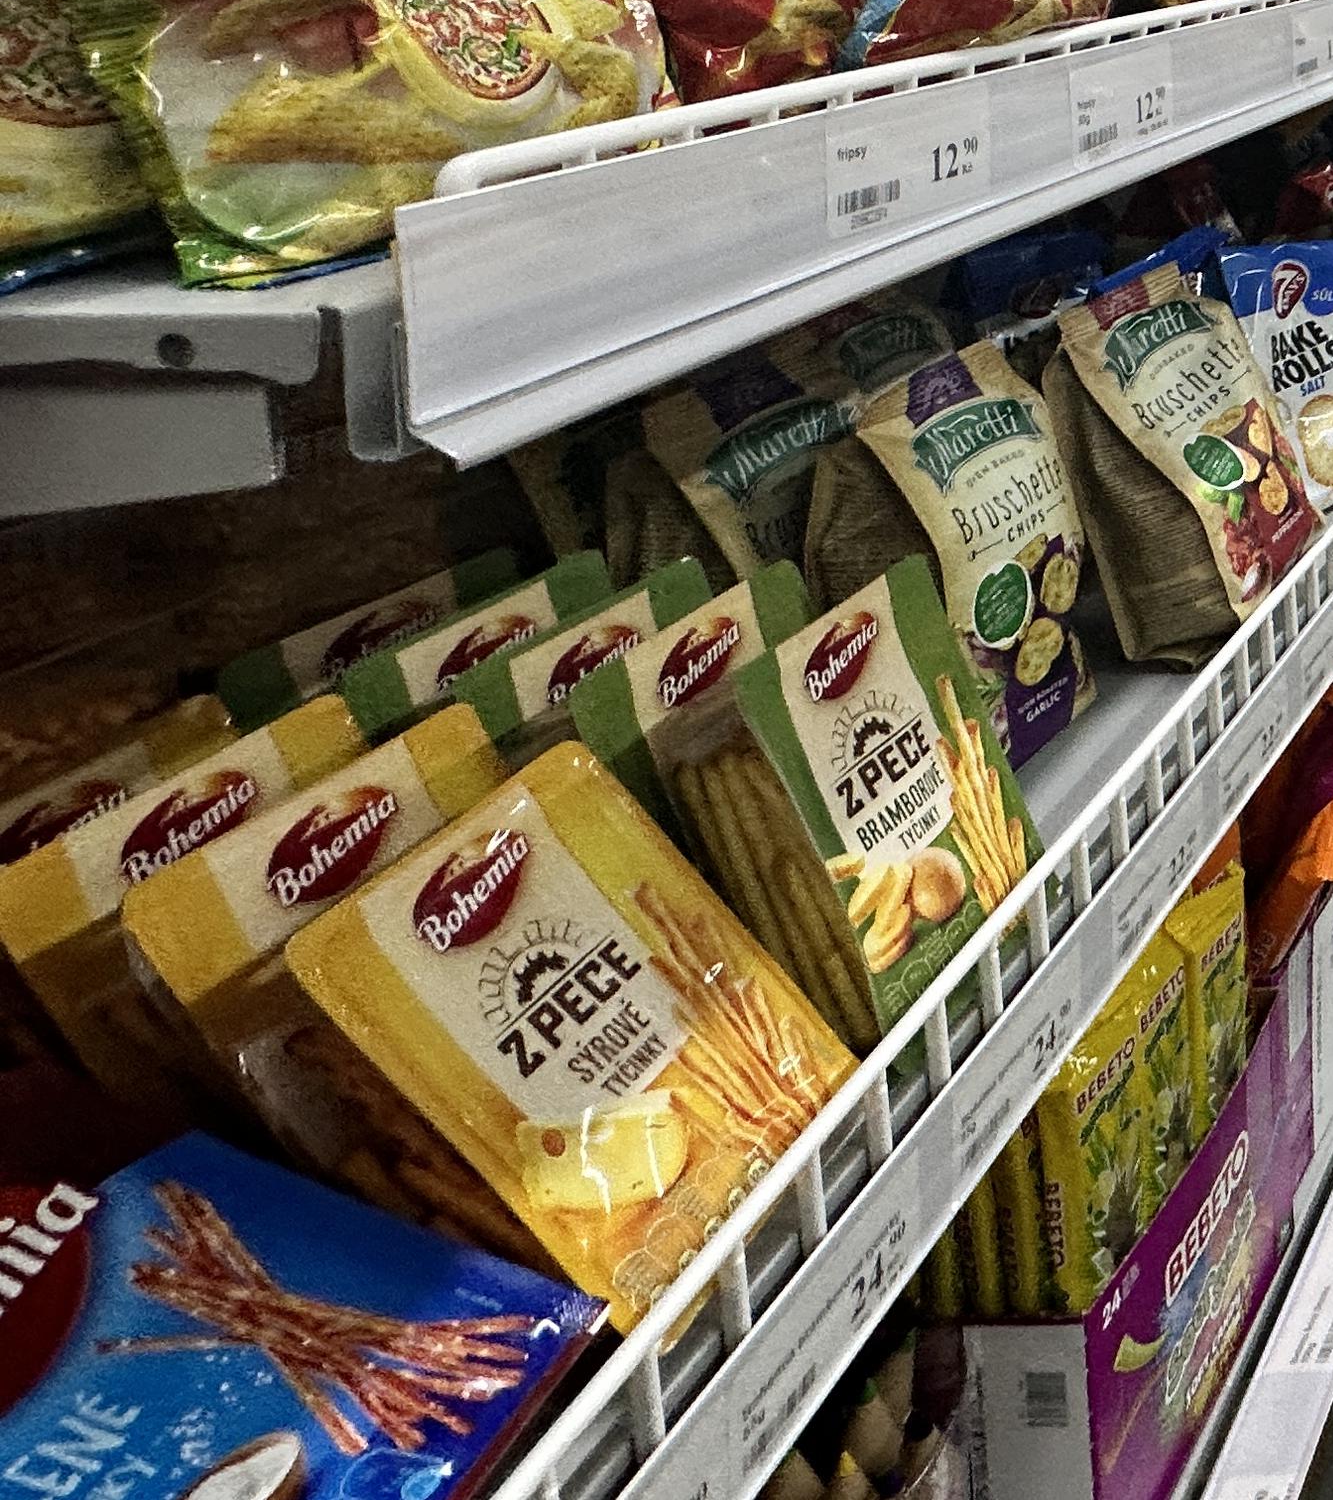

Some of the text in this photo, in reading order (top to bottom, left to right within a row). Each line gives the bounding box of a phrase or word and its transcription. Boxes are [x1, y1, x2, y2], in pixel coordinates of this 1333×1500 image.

[1135, 91, 1154, 124] 12
[836, 144, 868, 162] fripsy
[931, 141, 960, 183] 12
[963, 135, 979, 157] 90
[1271, 320, 1330, 362] BAKE
[1187, 385, 1232, 424] CHIPS
[1299, 376, 1326, 397] SALT
[1006, 508, 1047, 543] CHIPS
[659, 617, 742, 709] Bohemia
[804, 612, 880, 704] Bohemia
[1025, 689, 1063, 723] GARLIC
[835, 717, 933, 821] Z PECE
[856, 762, 948, 855] BRAMBOROVÉ
[124, 775, 258, 884] Bohemia
[268, 790, 399, 909] Bohemia
[897, 802, 944, 851] TYČINKY
[417, 832, 531, 954] Bohemia
[498, 941, 642, 1078] Z PECE
[1137, 963, 1186, 1034] BEBETO
[566, 999, 653, 1085] SÝROVÉ
[600, 1032, 670, 1099] TYČINKY
[1074, 1038, 1137, 1118] BEBETO
[1165, 1129, 1250, 1308] BEBETO
